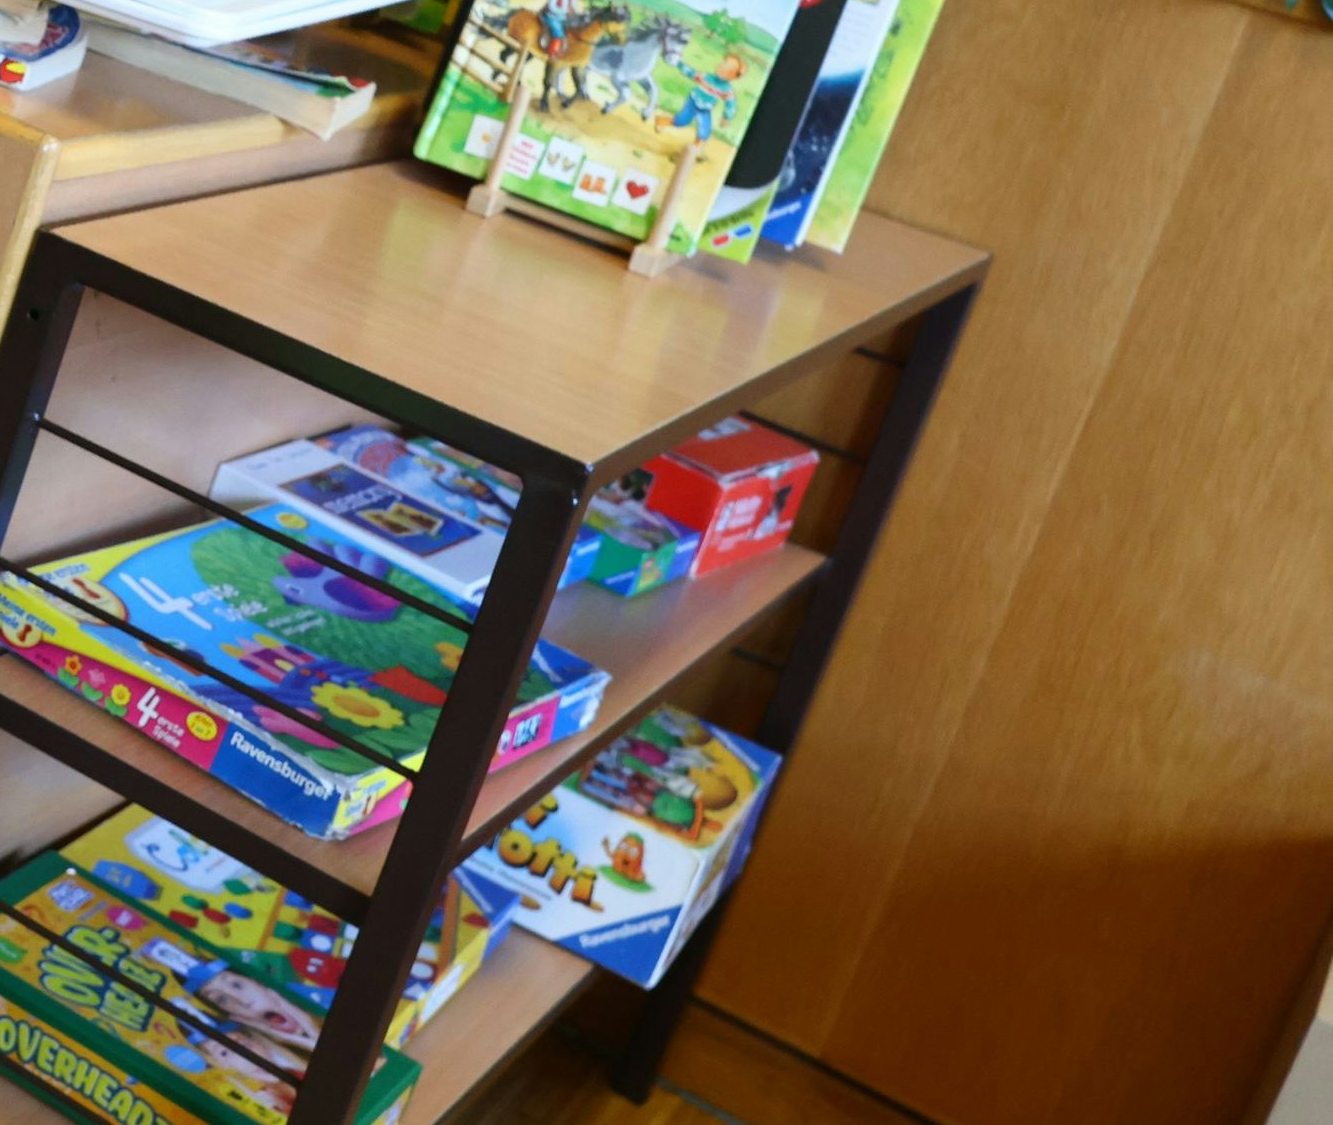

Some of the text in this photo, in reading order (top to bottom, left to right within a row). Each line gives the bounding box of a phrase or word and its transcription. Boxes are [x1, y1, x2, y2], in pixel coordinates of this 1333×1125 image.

[119, 572, 213, 631] 4
[136, 686, 161, 728] 4
[157, 716, 185, 737] erste
[153, 724, 181, 748] Spiele
[230, 731, 332, 802] Ravensburger
